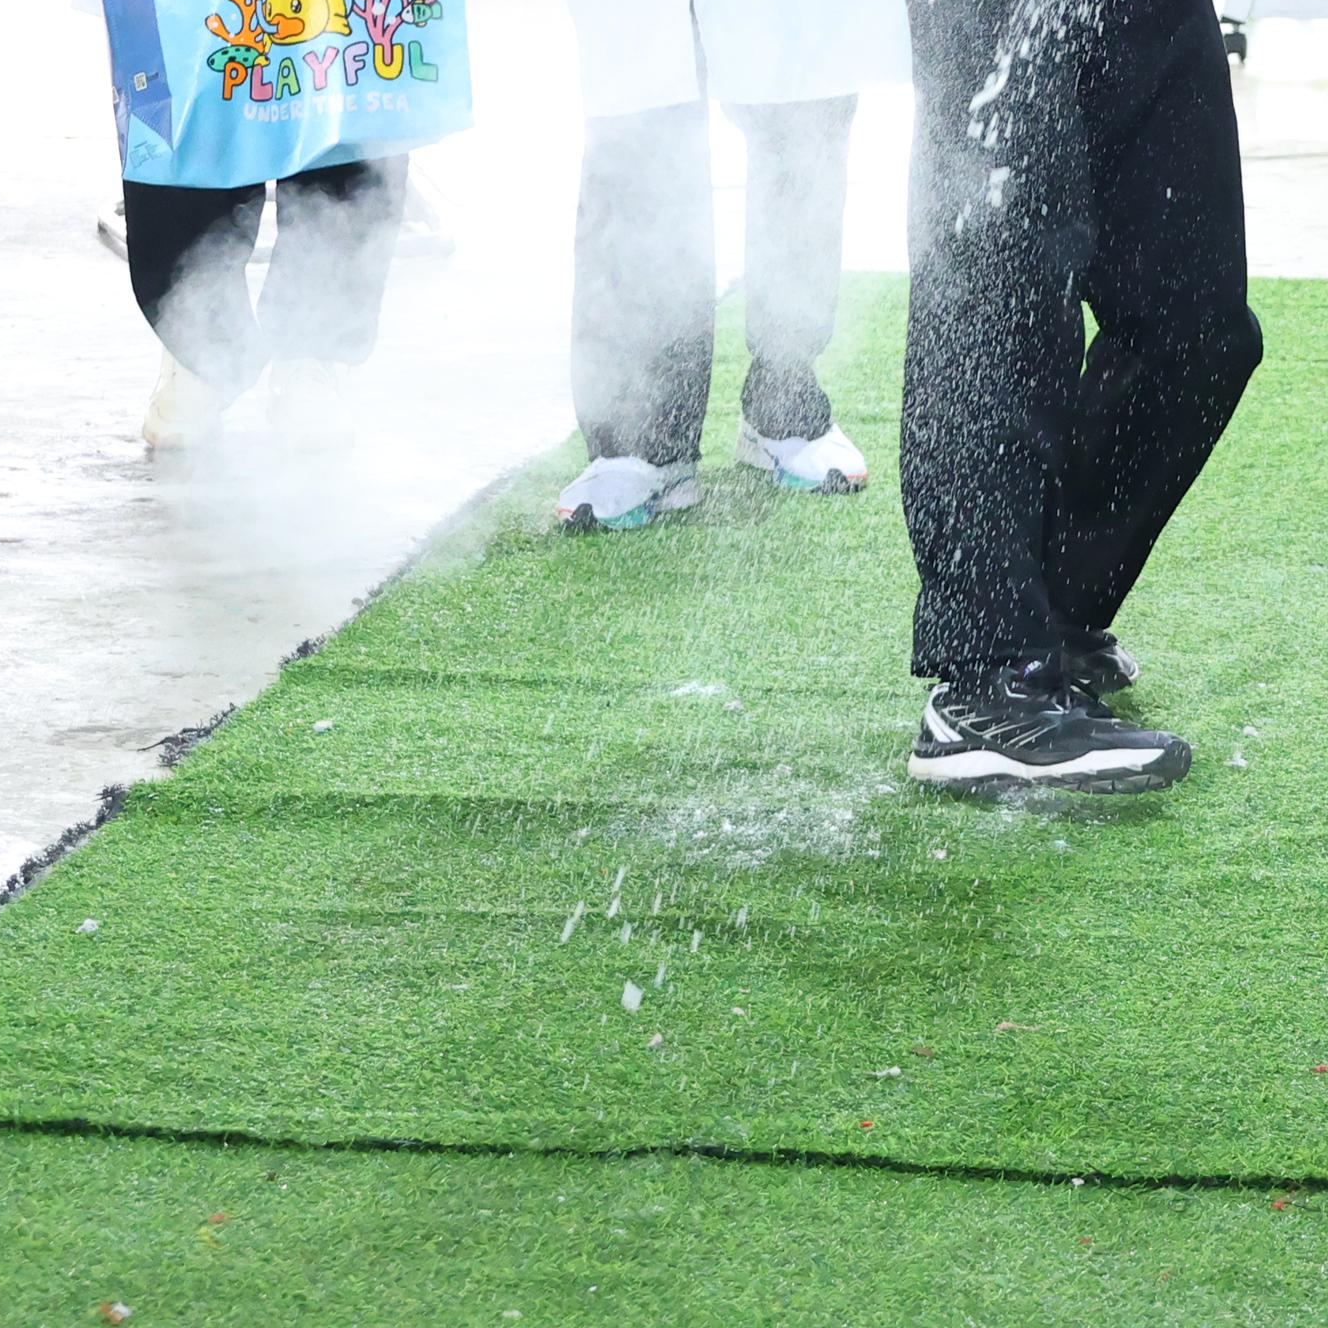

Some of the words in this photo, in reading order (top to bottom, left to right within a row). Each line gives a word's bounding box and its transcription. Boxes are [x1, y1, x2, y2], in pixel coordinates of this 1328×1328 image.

[222, 40, 439, 103] PLAYFUL
[243, 100, 304, 123] UNDER
[366, 91, 412, 113] SEA
